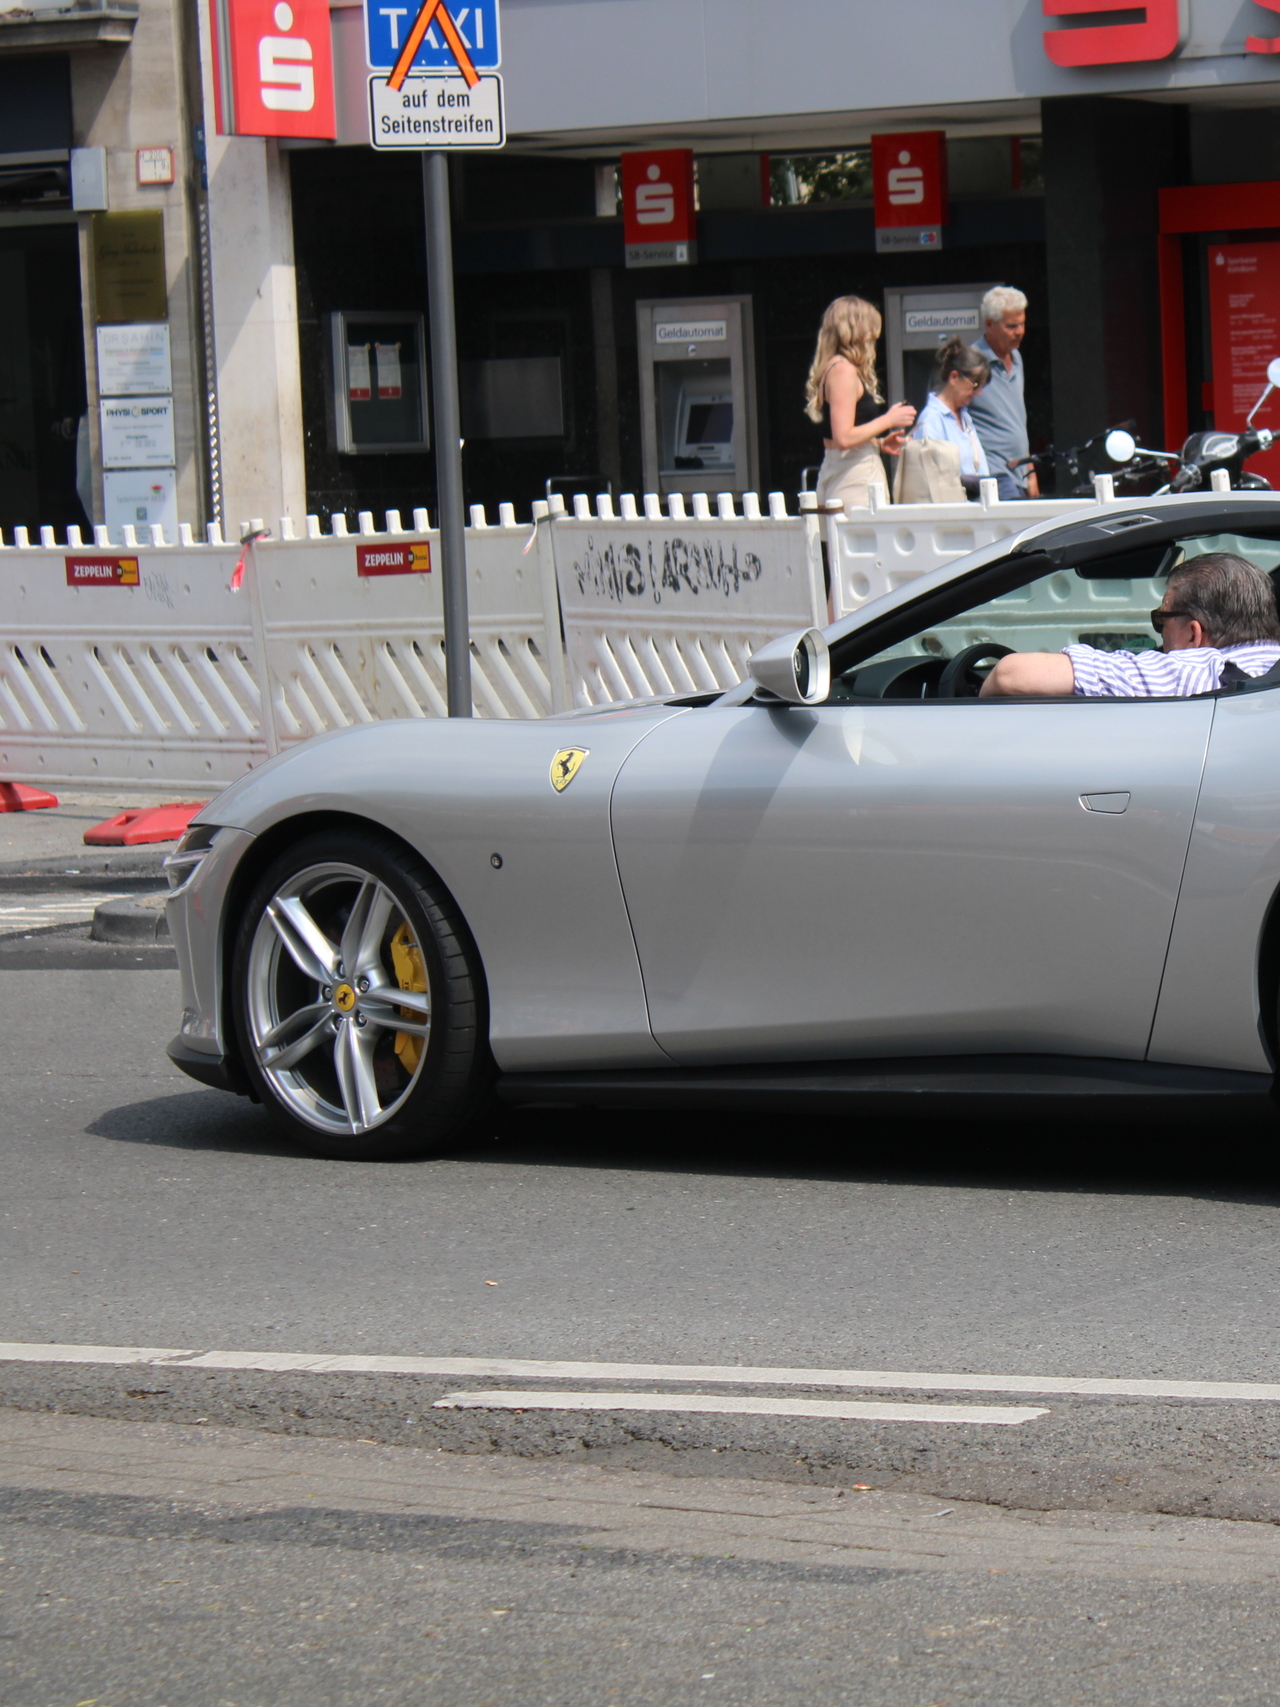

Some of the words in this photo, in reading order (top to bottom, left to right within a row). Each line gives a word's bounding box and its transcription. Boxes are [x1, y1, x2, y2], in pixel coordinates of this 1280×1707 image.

[379, 8, 484, 49] TAXI
[402, 89, 428, 108] auf
[437, 89, 470, 107] dem
[381, 113, 494, 134] Seitenstreifen
[908, 315, 977, 328] Geldautomat
[658, 326, 724, 339] Geldautomat
[364, 552, 404, 567] ZEPPELIN
[74, 565, 112, 578] ZEPPELIN
